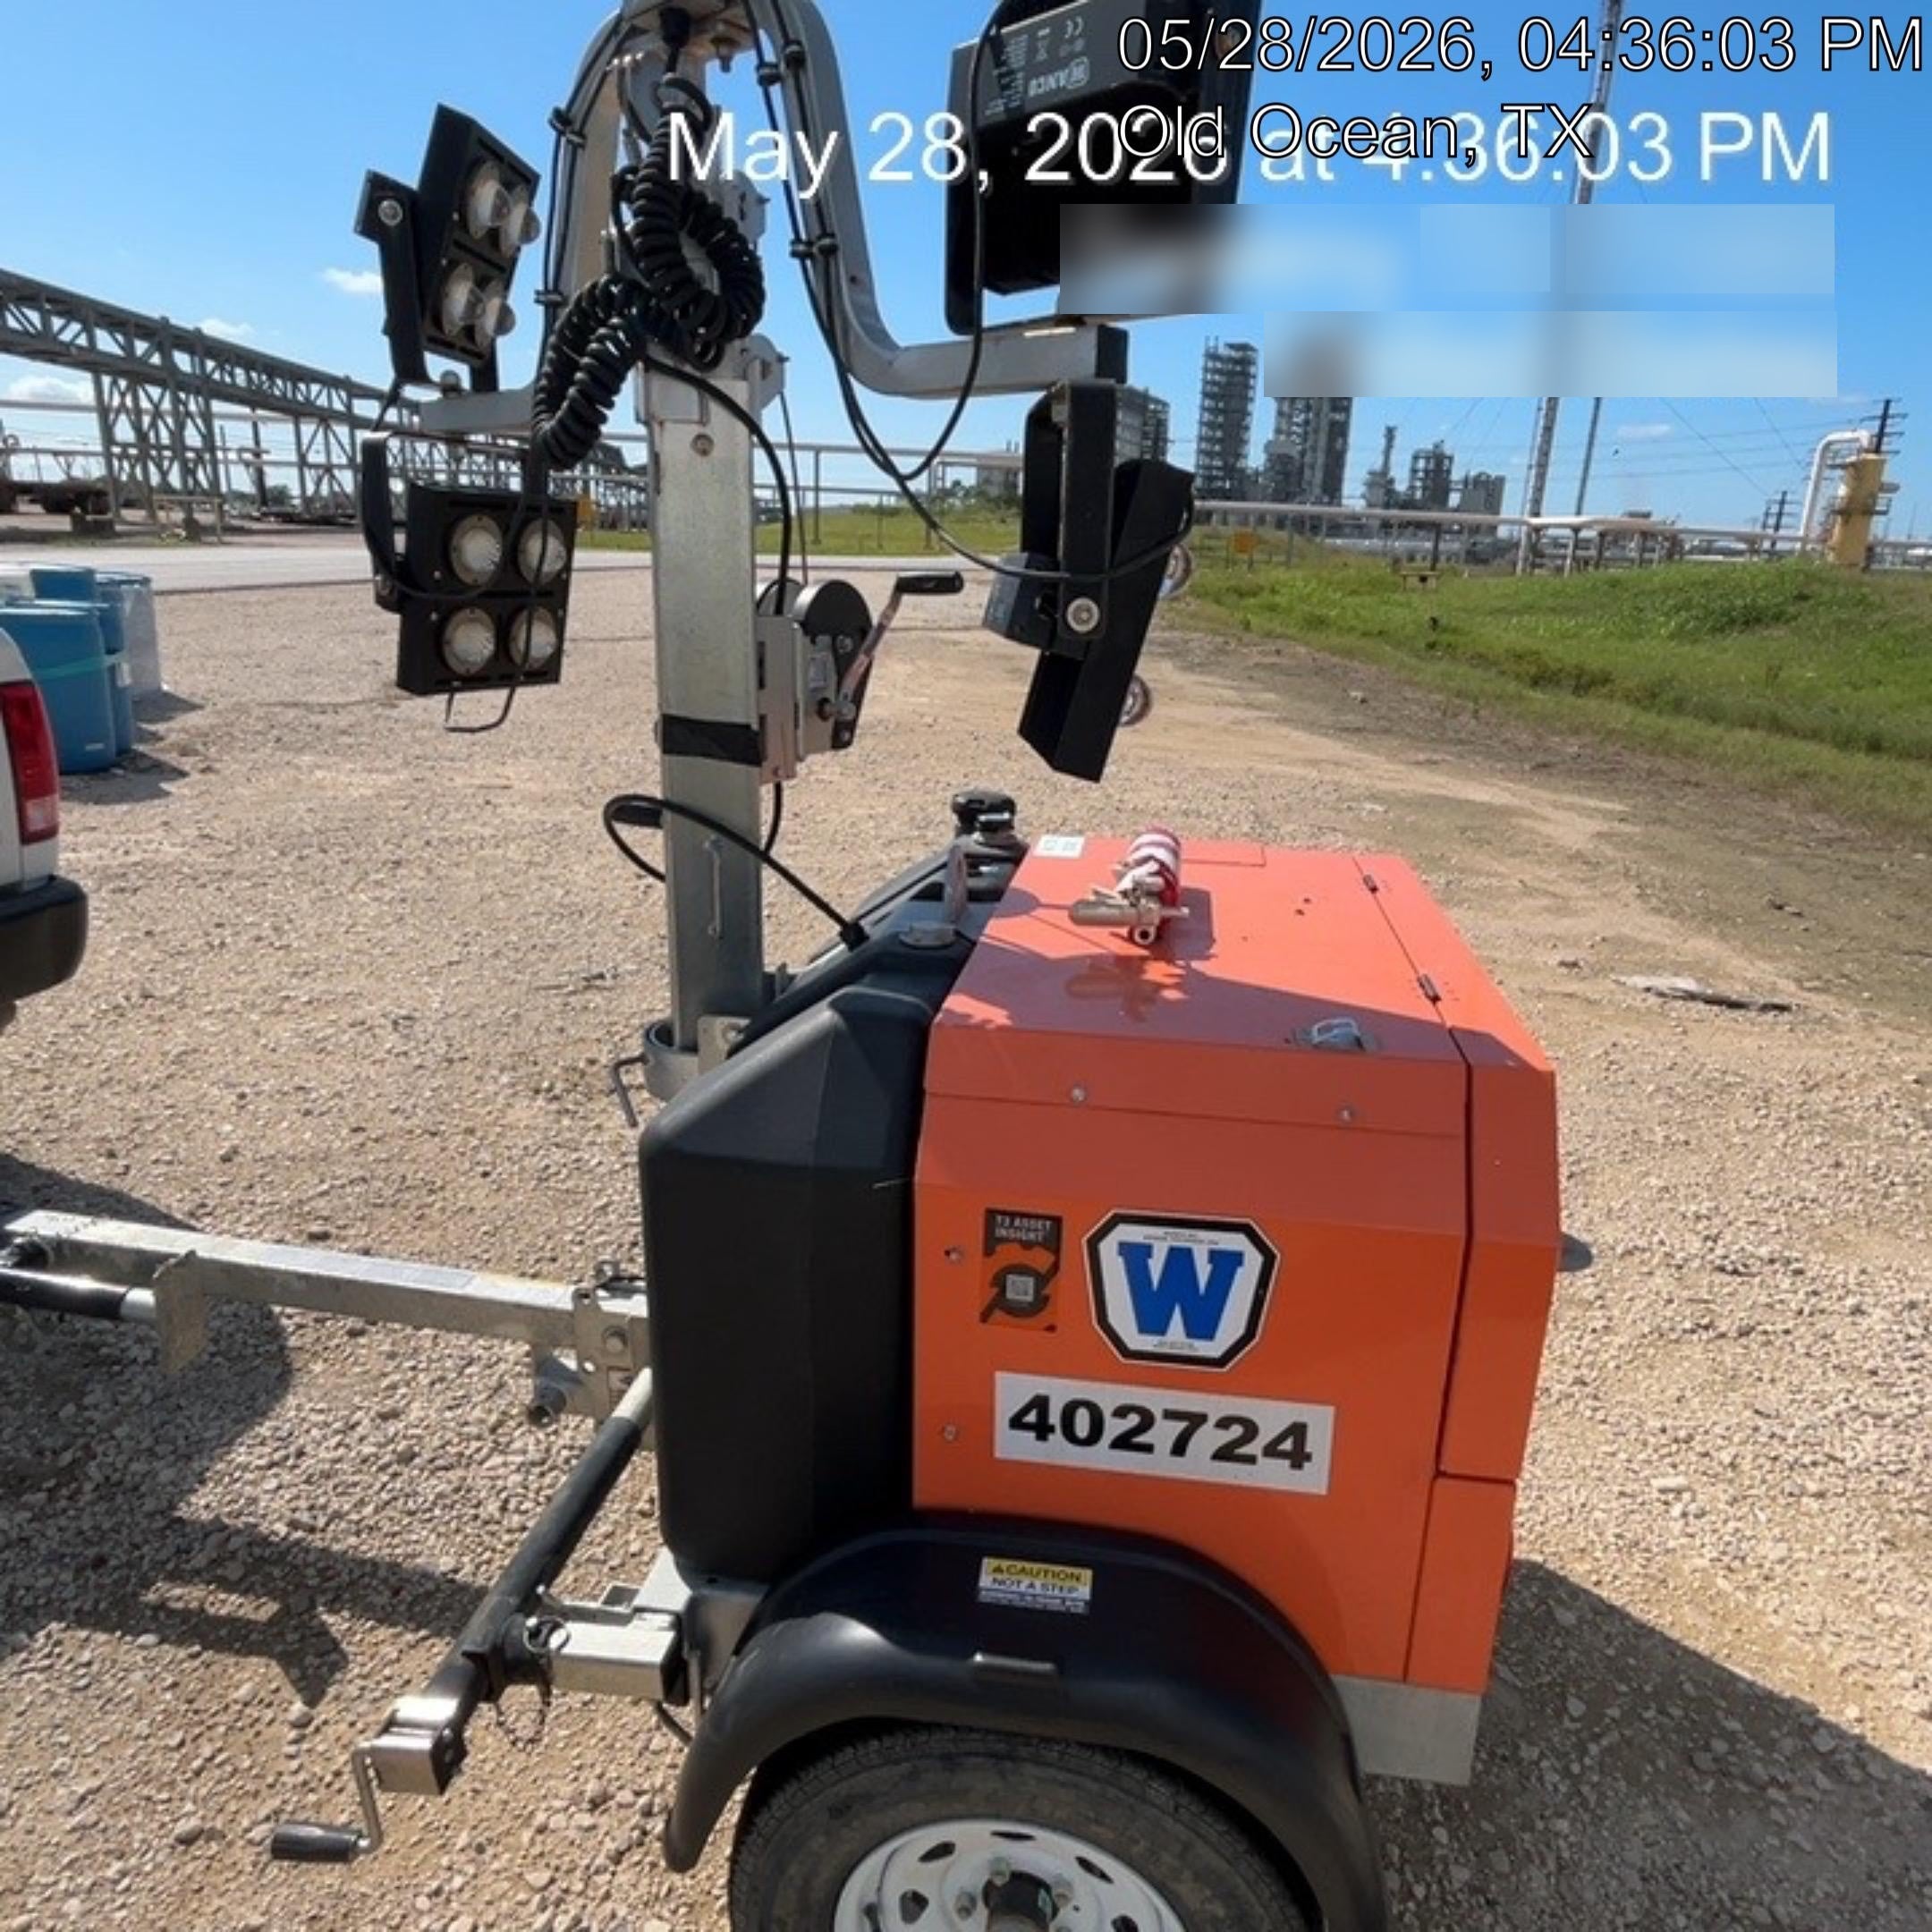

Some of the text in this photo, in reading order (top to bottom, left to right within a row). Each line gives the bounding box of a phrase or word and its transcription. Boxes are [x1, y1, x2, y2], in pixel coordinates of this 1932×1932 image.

[1013, 1217, 1052, 1232] ASSET
[994, 1228, 1044, 1242] INSIGHT
[1117, 1241, 1245, 1342] W
[1008, 1394, 1313, 1471] 402724
[1006, 1564, 1082, 1581] CAUTION
